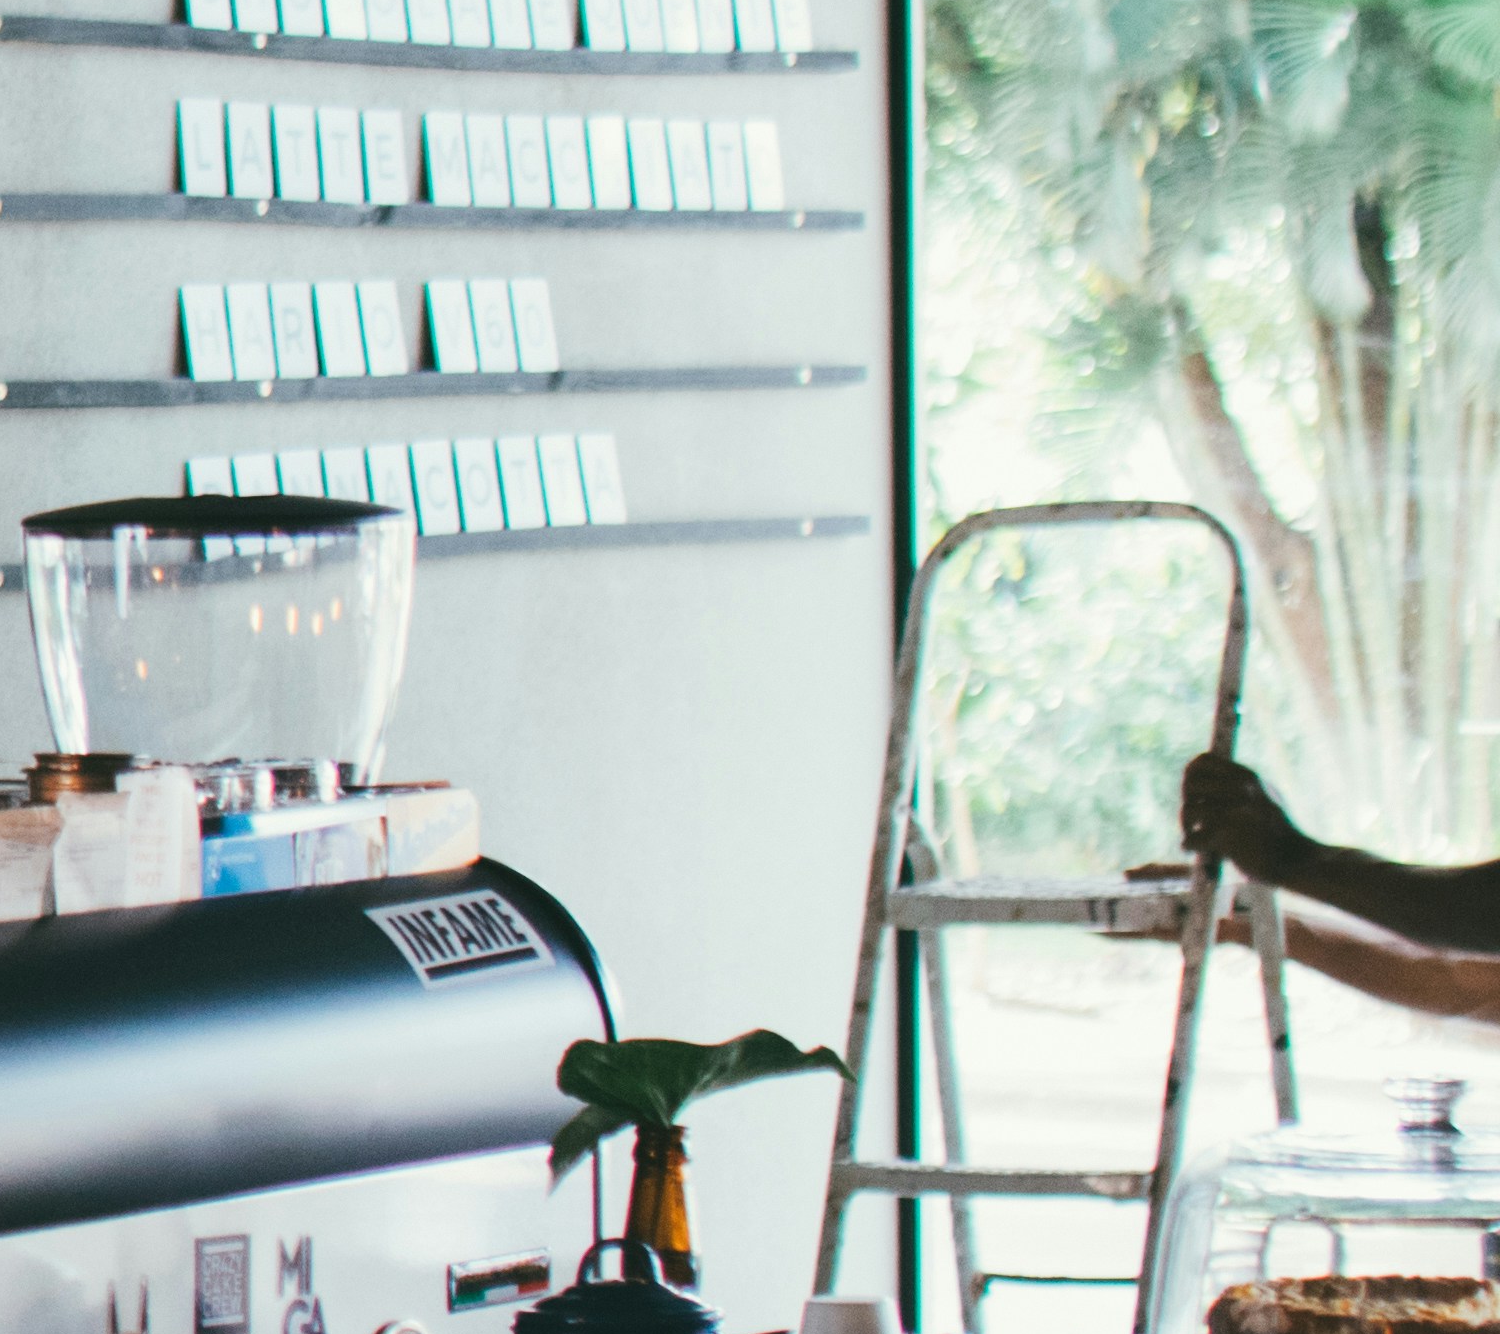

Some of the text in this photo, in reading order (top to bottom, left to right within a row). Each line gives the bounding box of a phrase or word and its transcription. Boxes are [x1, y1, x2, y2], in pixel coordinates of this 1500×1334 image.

[191, 123, 399, 182] LATTE
[194, 303, 396, 356] HARIO
[386, 897, 528, 965] INFAME
